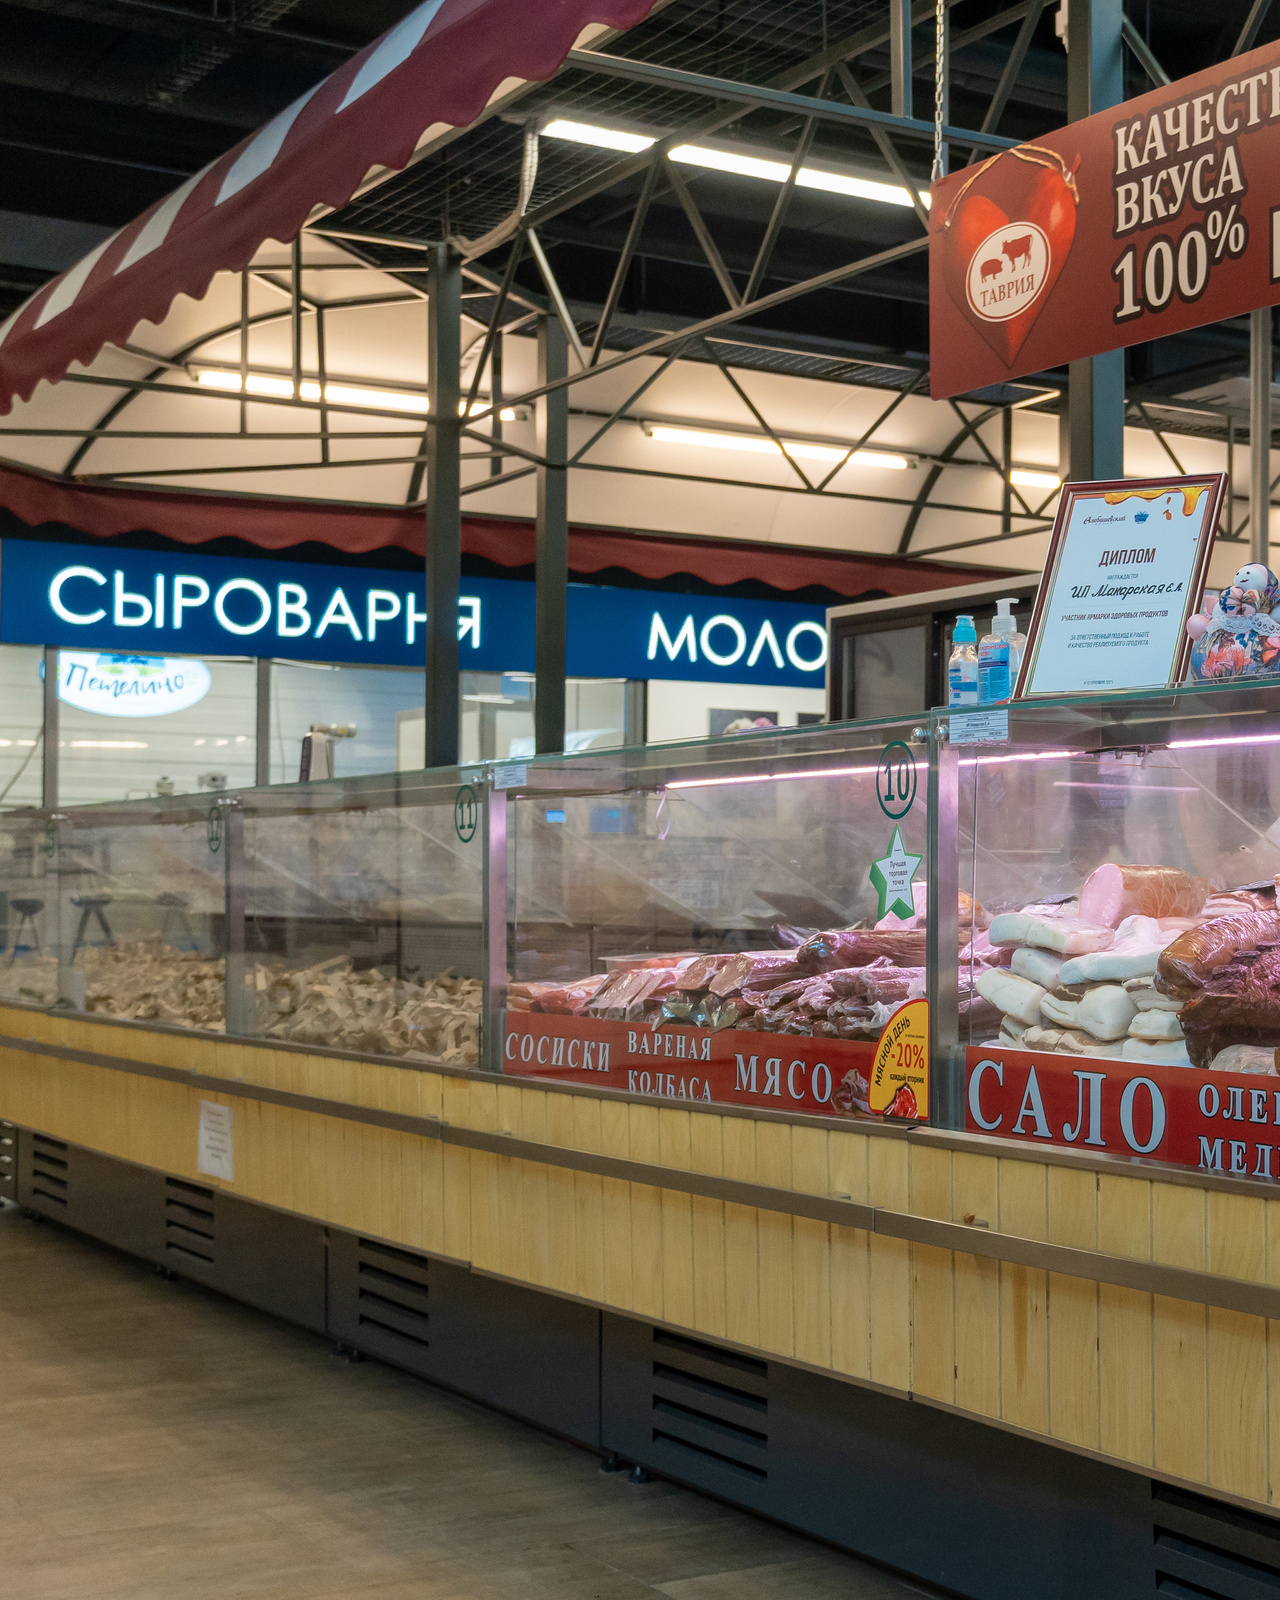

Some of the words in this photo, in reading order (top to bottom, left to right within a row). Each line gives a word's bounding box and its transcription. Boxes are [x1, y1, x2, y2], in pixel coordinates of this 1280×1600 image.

[1115, 145, 1245, 234] ВКУСА
[1114, 204, 1246, 319] 100%
[979, 273, 1036, 308] ТАВРИЯ
[1098, 547, 1157, 567] ДИПЛОМ
[1061, 614, 1087, 622] УЧАСТНИК
[1087, 613, 1110, 621] ЯРМАРКИ
[1111, 611, 1138, 620] ЗДОРОВЫХ
[1139, 610, 1169, 618] ПРОДУКТОВ
[646, 611, 828, 674] МОЛО
[883, 758, 910, 802] 10
[459, 797, 474, 830] 11
[888, 869, 908, 877] торговая
[889, 860, 907, 869] Лучшая
[505, 1032, 610, 1072] СОСИСКИ
[628, 1031, 712, 1061] ВАРЕНАЯ
[875, 1034, 894, 1087] МЯСНОЙ
[892, 1015, 911, 1041] ДЕНЬ
[891, 1042, 925, 1069] -20%
[628, 1069, 711, 1102] КОЛБАСА
[734, 1053, 833, 1104] МЯСО
[890, 1073, 907, 1082] каждый
[907, 1074, 925, 1084] вторник
[967, 1059, 1167, 1155] САЛО
